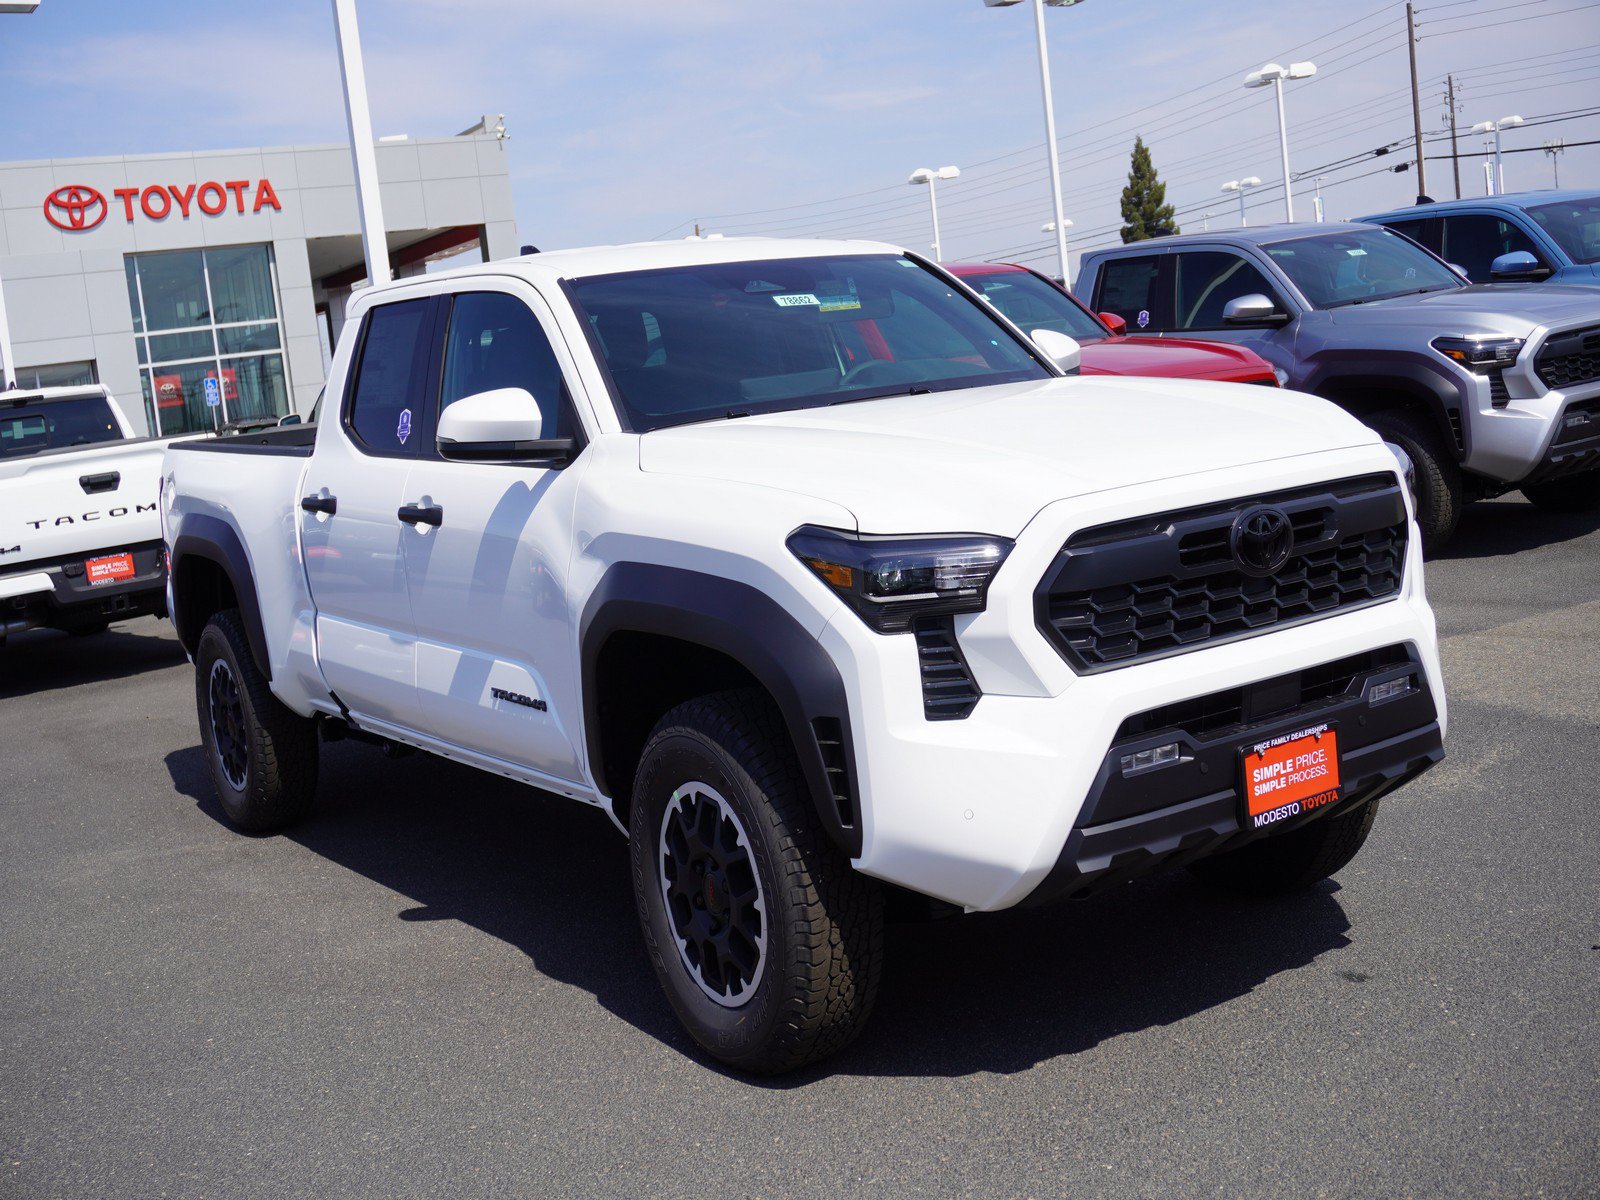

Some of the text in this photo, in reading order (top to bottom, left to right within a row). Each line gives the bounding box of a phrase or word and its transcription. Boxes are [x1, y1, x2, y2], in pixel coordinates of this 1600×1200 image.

[114, 179, 281, 221] TOYOTA
[779, 296, 813, 305] 78862
[26, 503, 157, 529] TACOM
[1253, 724, 1328, 752] PRICE FAMILY DEALERSHIPS
[1253, 749, 1328, 783] SIMPLE PRICE.
[1254, 764, 1329, 796] SIMPLE PROCESS.
[1254, 789, 1339, 828] MODESTO TOYOTA
